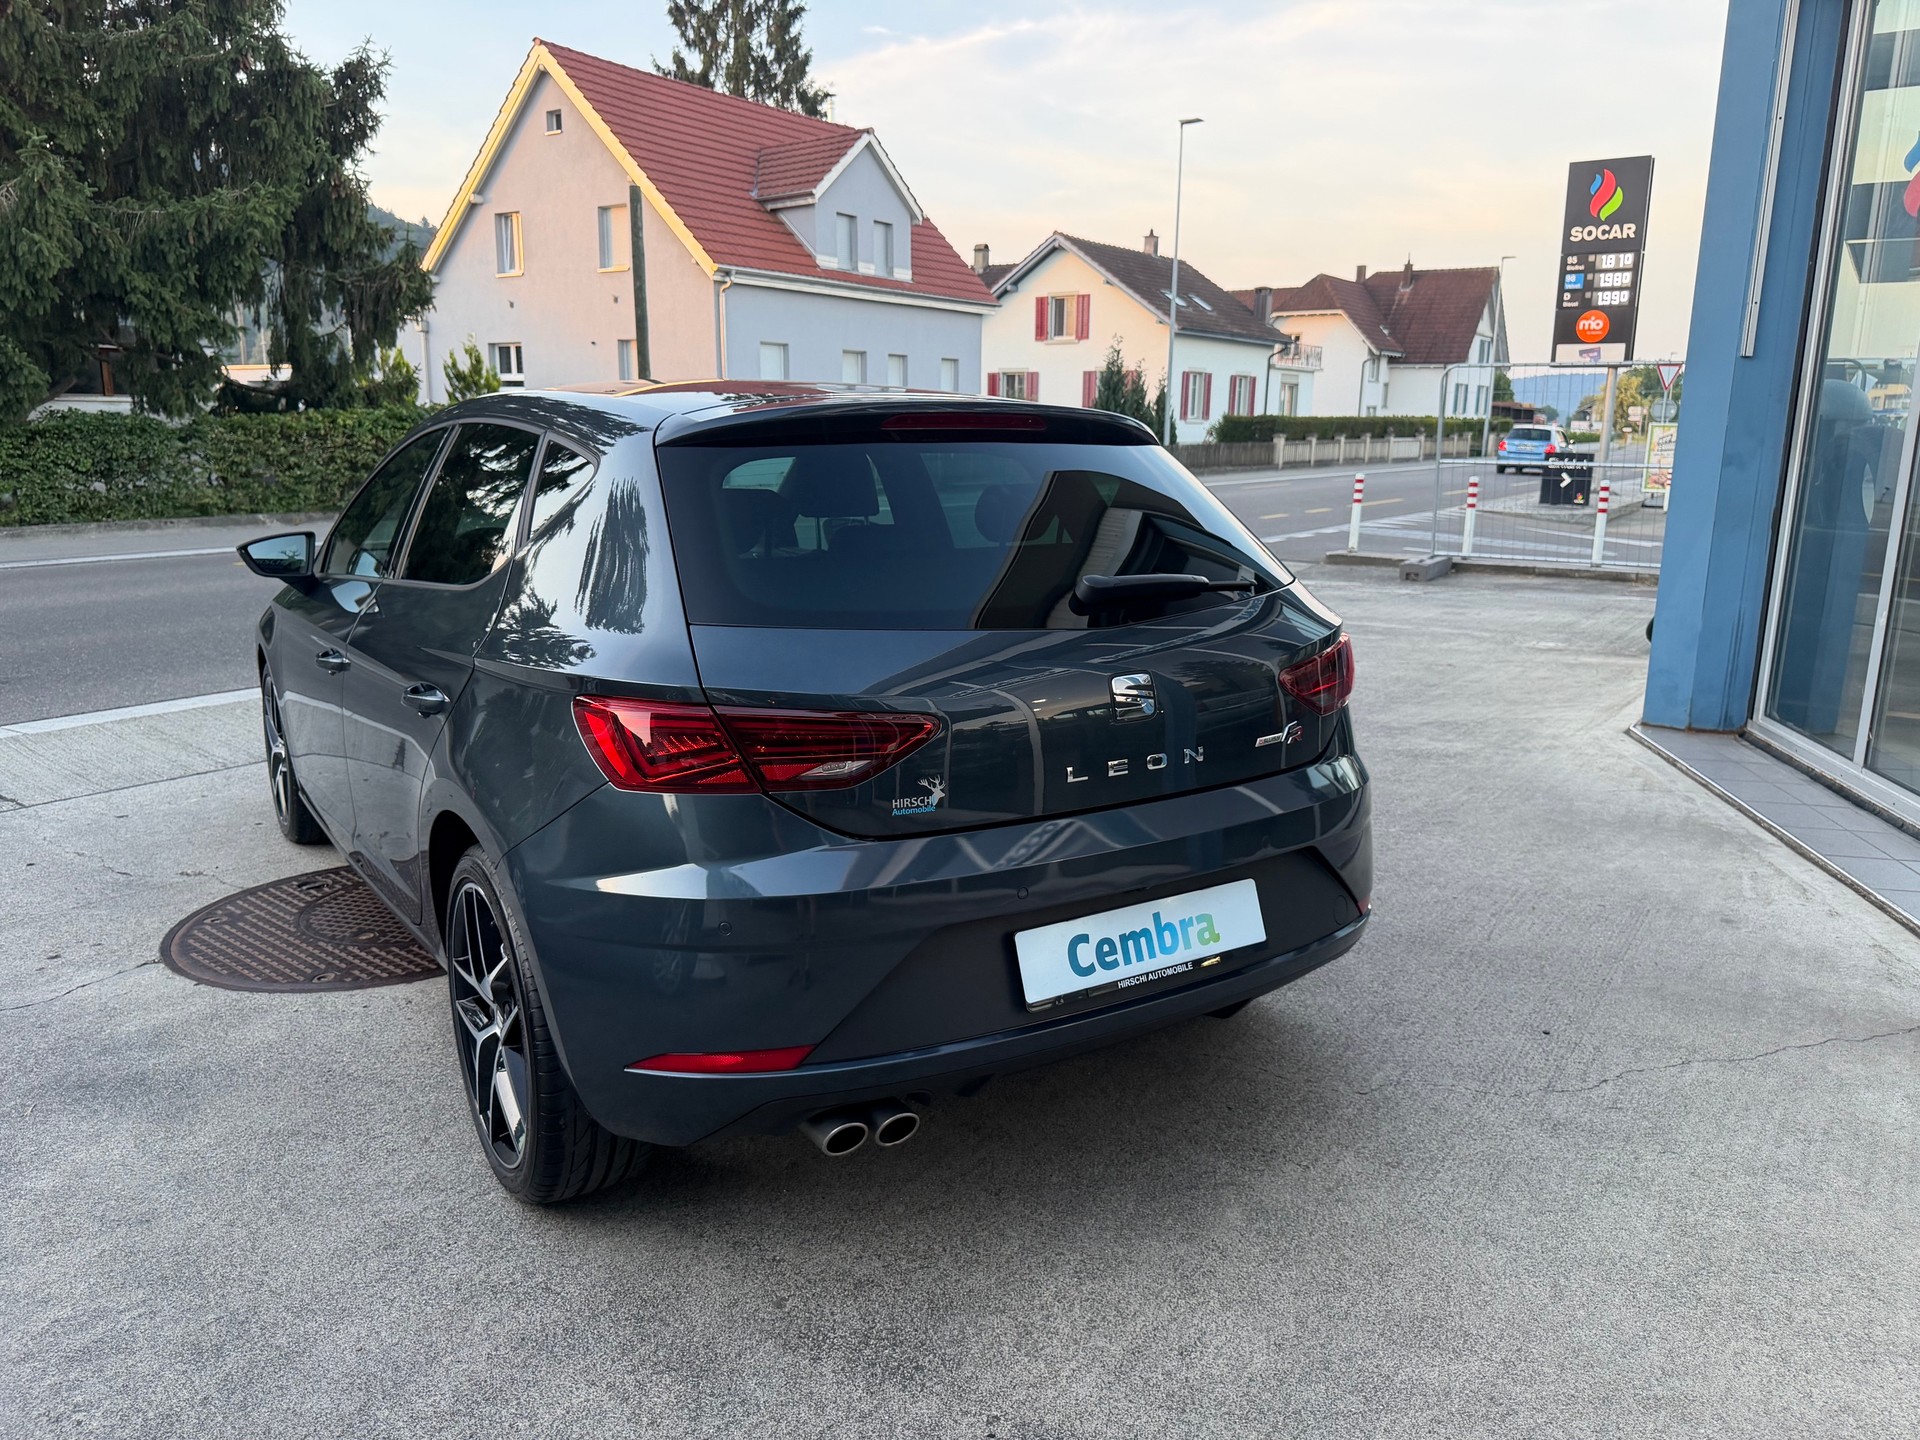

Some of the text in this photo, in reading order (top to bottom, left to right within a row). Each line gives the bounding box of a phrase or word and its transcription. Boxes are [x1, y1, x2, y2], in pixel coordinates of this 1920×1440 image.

[1569, 223, 1636, 242] SOCAR
[1578, 316, 1604, 330] mio
[1066, 746, 1204, 783] LEON
[891, 805, 936, 817] Automobile
[1067, 911, 1221, 977] Cembra
[1117, 961, 1194, 989] HIRSCHI AUTOMOBILE
